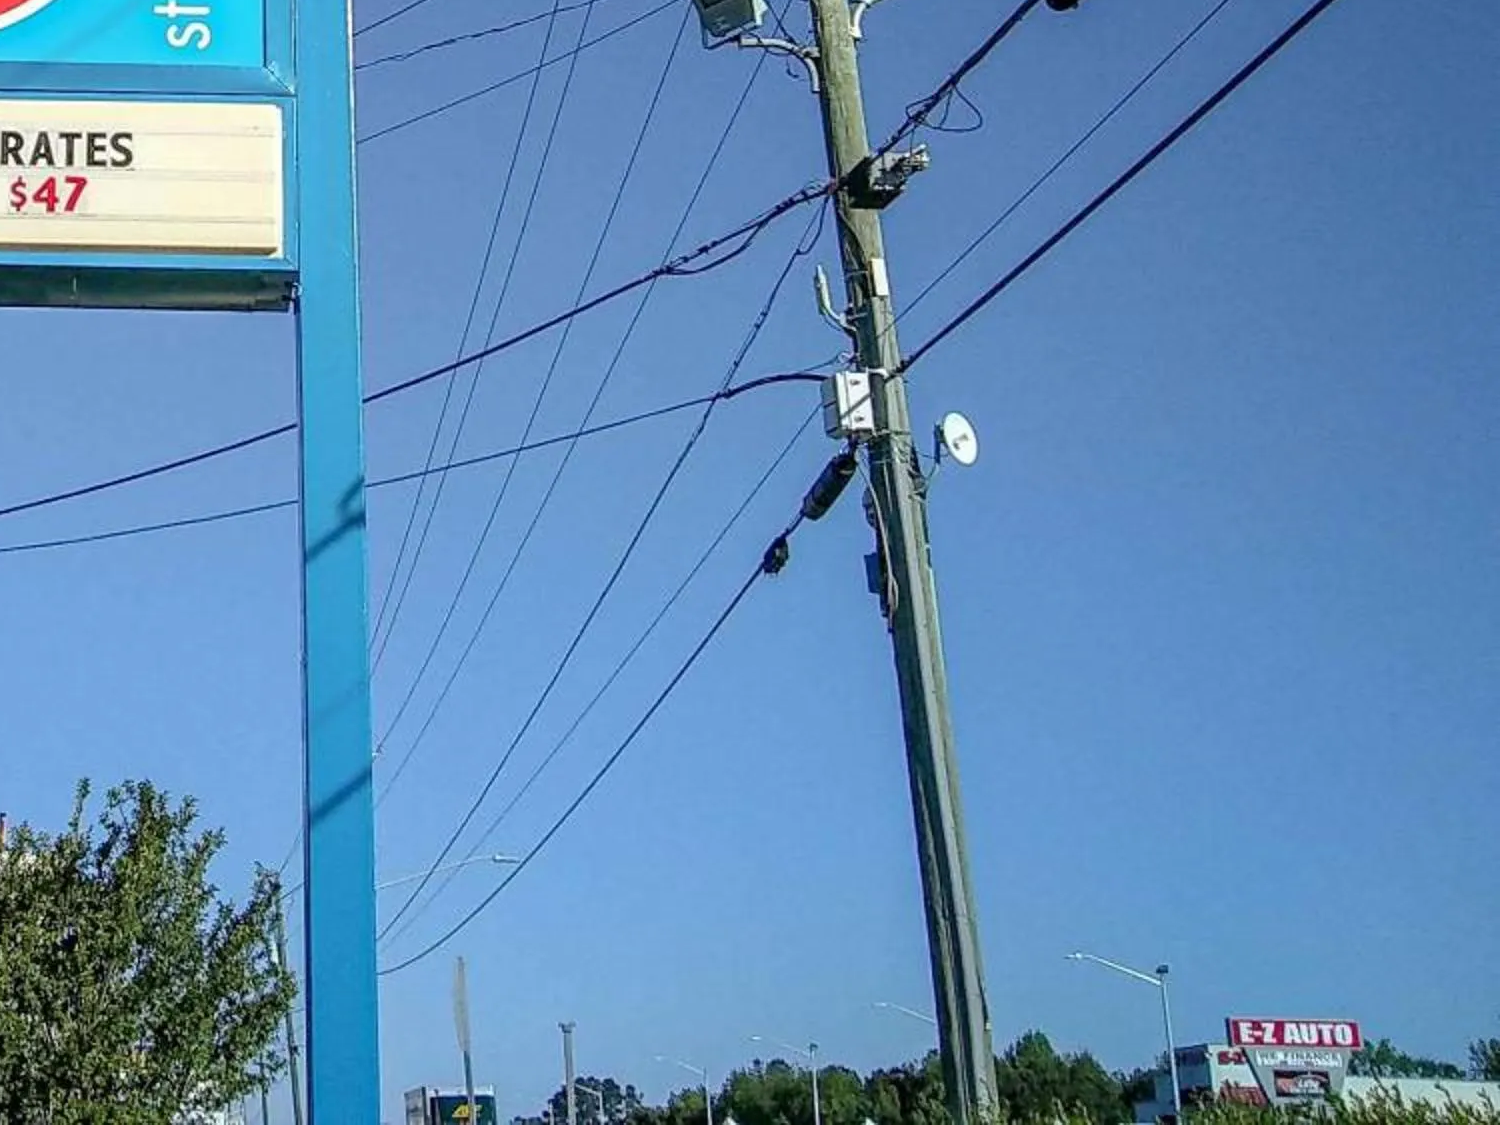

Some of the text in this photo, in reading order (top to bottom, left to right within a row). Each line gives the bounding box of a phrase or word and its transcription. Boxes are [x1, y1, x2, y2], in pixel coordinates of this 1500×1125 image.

[0, 131, 134, 168] RATES
[10, 176, 88, 213] $47
[1238, 1022, 1353, 1046] E-Z AUTO
